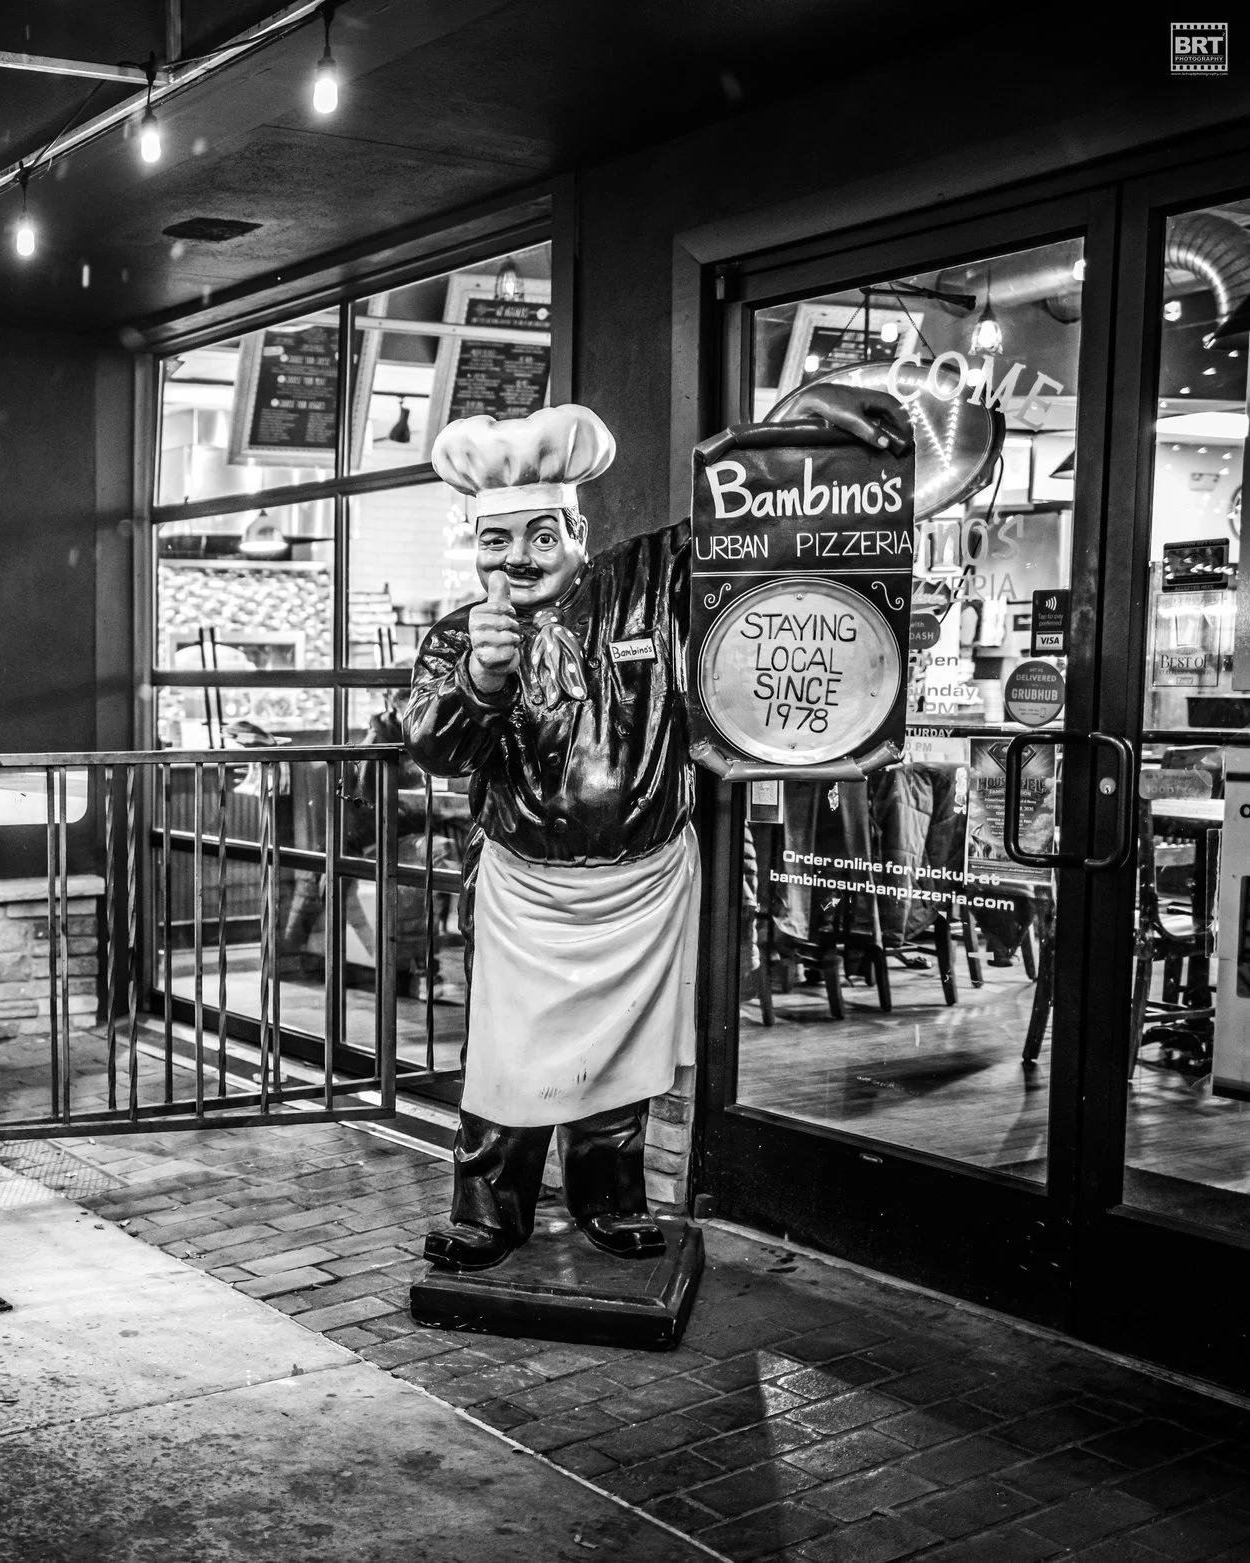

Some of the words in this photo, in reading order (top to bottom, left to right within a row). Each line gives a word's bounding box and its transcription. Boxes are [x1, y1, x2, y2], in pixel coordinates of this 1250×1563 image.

[705, 458, 902, 519] Bambino's
[695, 534, 769, 560] URBAN
[796, 531, 913, 557] PIZZERIA
[740, 612, 857, 642] STAYING
[1040, 637, 1060, 645] VISA
[612, 644, 653, 659] Bambino's
[755, 643, 843, 675] LOCAL
[753, 673, 841, 706] SINCE
[1016, 674, 1057, 682] DELIVERED
[1011, 688, 1058, 701] GRUBHUB
[765, 702, 829, 733] 1978
[916, 743, 932, 752] PM
[783, 850, 832, 866] Order
[834, 858, 883, 873] online
[886, 861, 912, 876] for
[915, 864, 975, 886] pickup
[979, 874, 1000, 886] at
[770, 869, 1015, 912] bambinosurbanpizzeria.com
